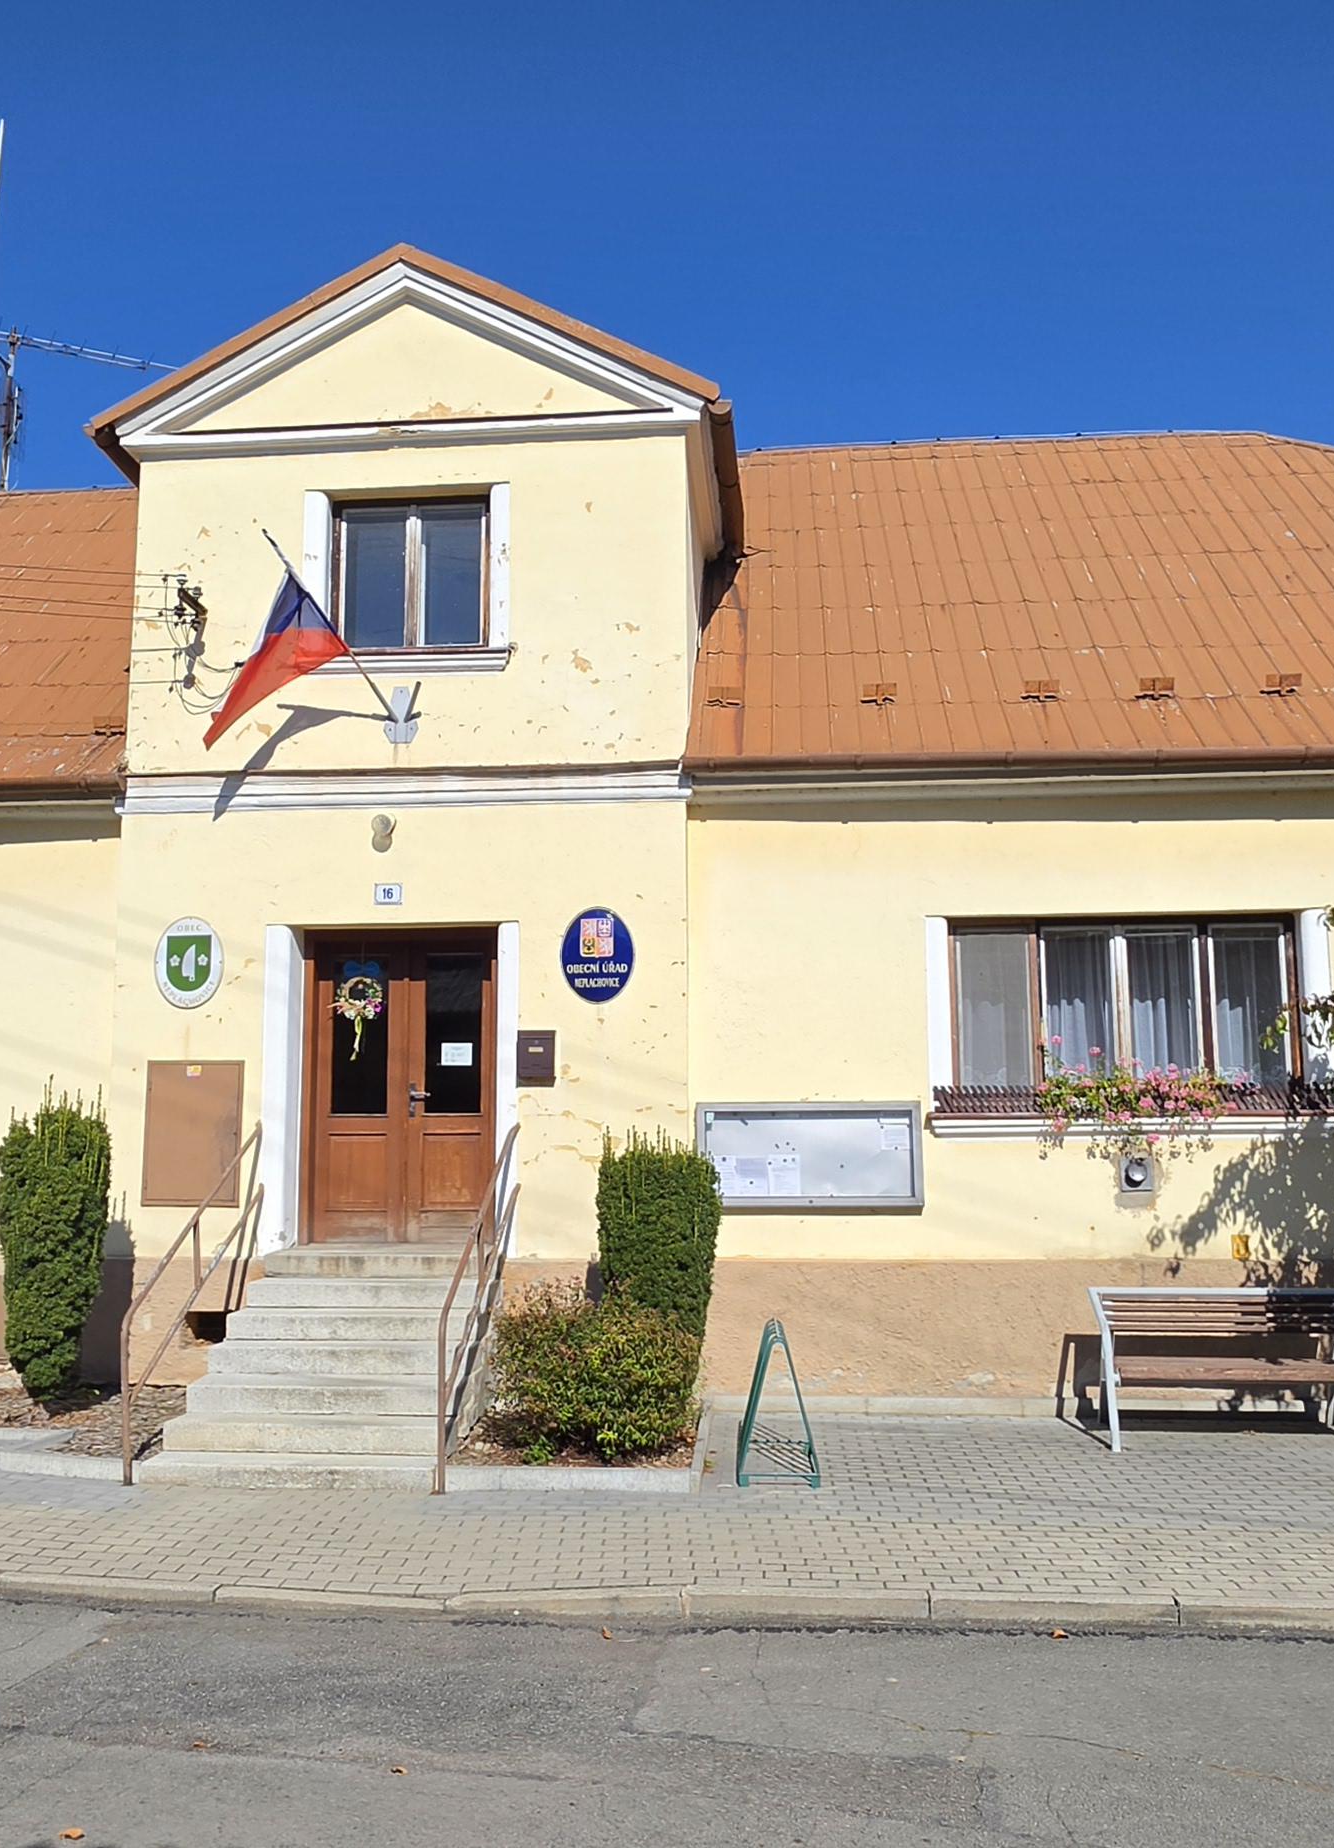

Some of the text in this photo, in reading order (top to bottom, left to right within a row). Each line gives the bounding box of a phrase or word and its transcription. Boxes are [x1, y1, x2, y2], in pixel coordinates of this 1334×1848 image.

[382, 887, 393, 900] 16
[566, 960, 628, 974] OBECNÍ ÚŘAD
[574, 977, 620, 988] NEPLACHOVICE
[163, 980, 215, 1005] NEPLACHOVICE
